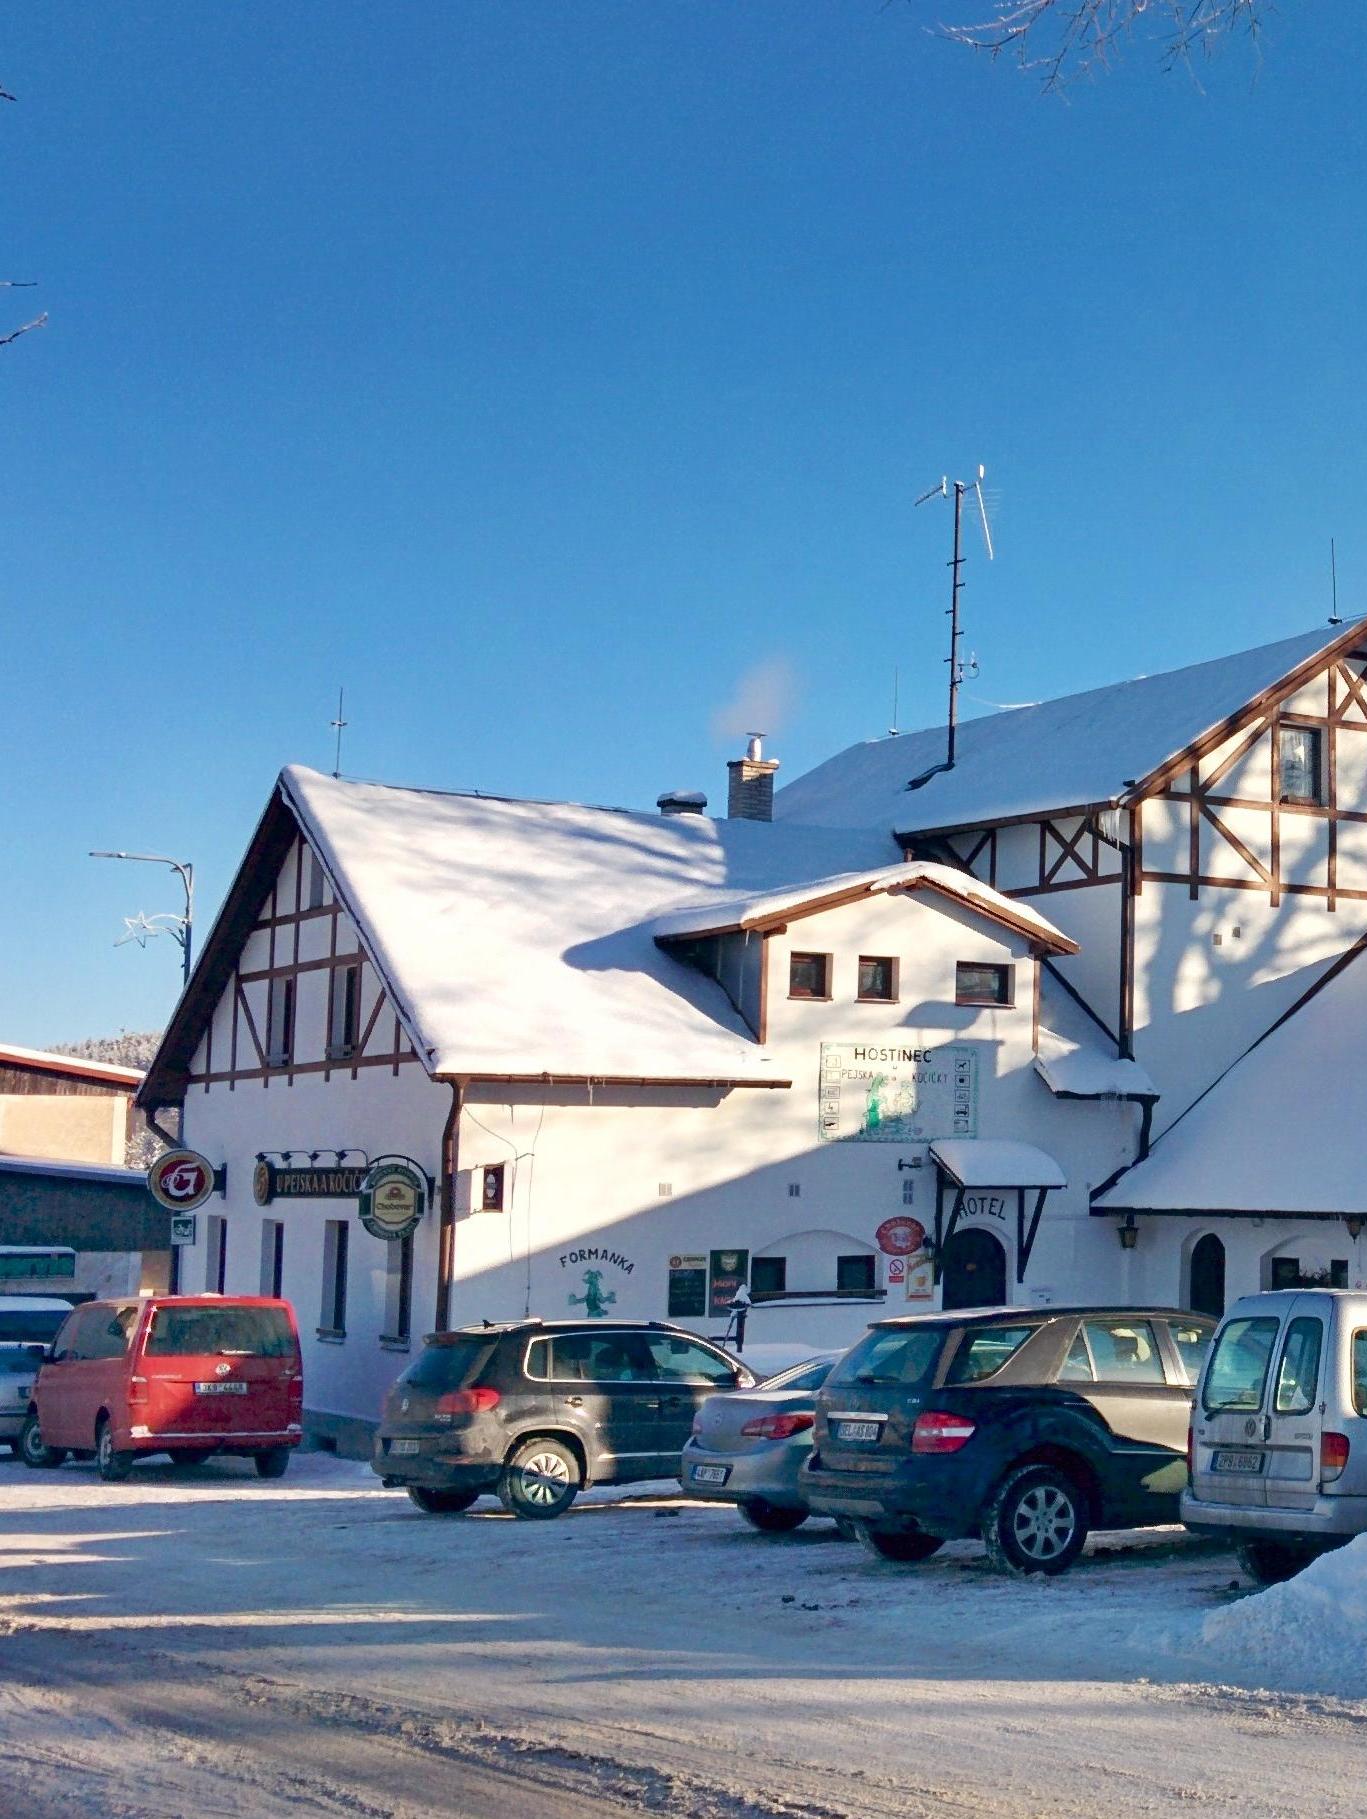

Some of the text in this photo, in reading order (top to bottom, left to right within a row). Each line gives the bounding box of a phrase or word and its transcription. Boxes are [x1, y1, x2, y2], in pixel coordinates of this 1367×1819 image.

[841, 1069, 874, 1080] PEJSKA
[276, 1174, 283, 1193] U
[284, 1174, 319, 1193] PEJSKA
[320, 1174, 328, 1193] A
[559, 1248, 635, 1275] FORMANKA
